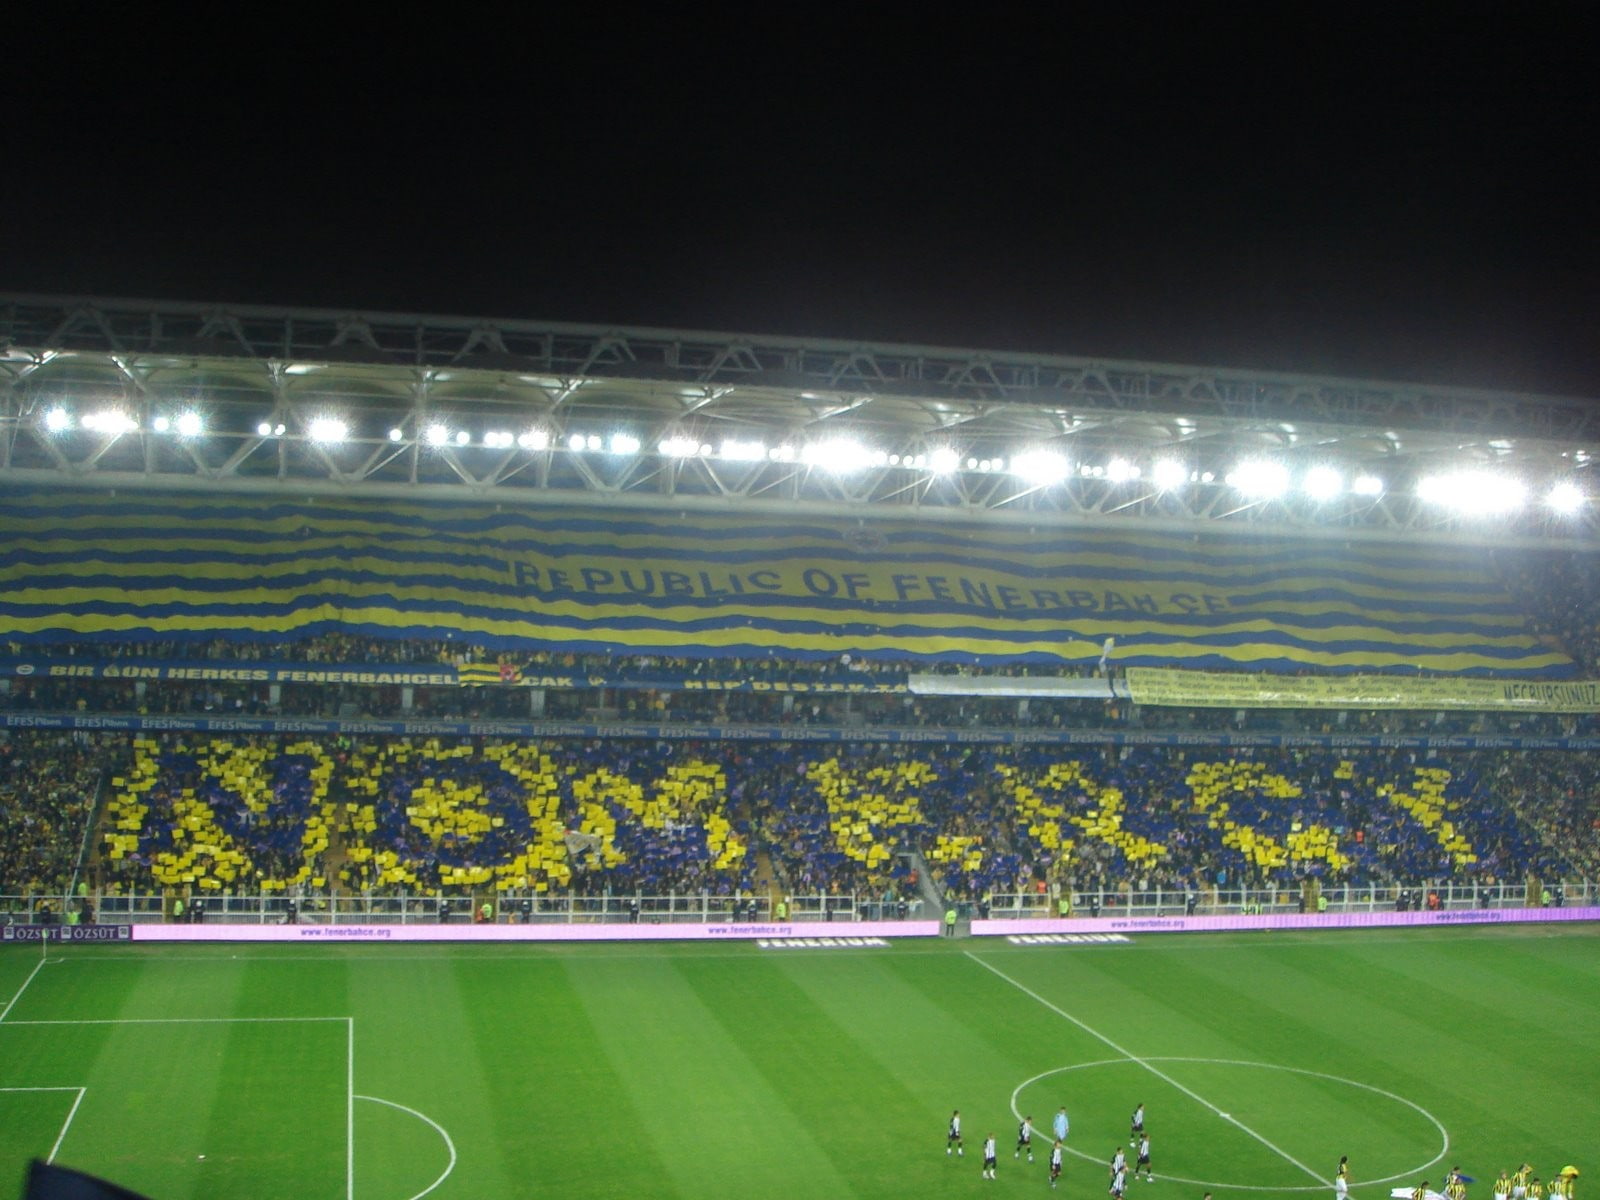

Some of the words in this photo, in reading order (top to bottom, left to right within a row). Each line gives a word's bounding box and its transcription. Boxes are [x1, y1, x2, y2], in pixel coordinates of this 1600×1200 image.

[513, 560, 783, 597] REPUBLIC
[803, 568, 872, 599] OF
[167, 668, 269, 680] HERKES
[7, 717, 33, 726] EFES
[74, 718, 100, 727] EFES
[142, 719, 167, 728] EFES
